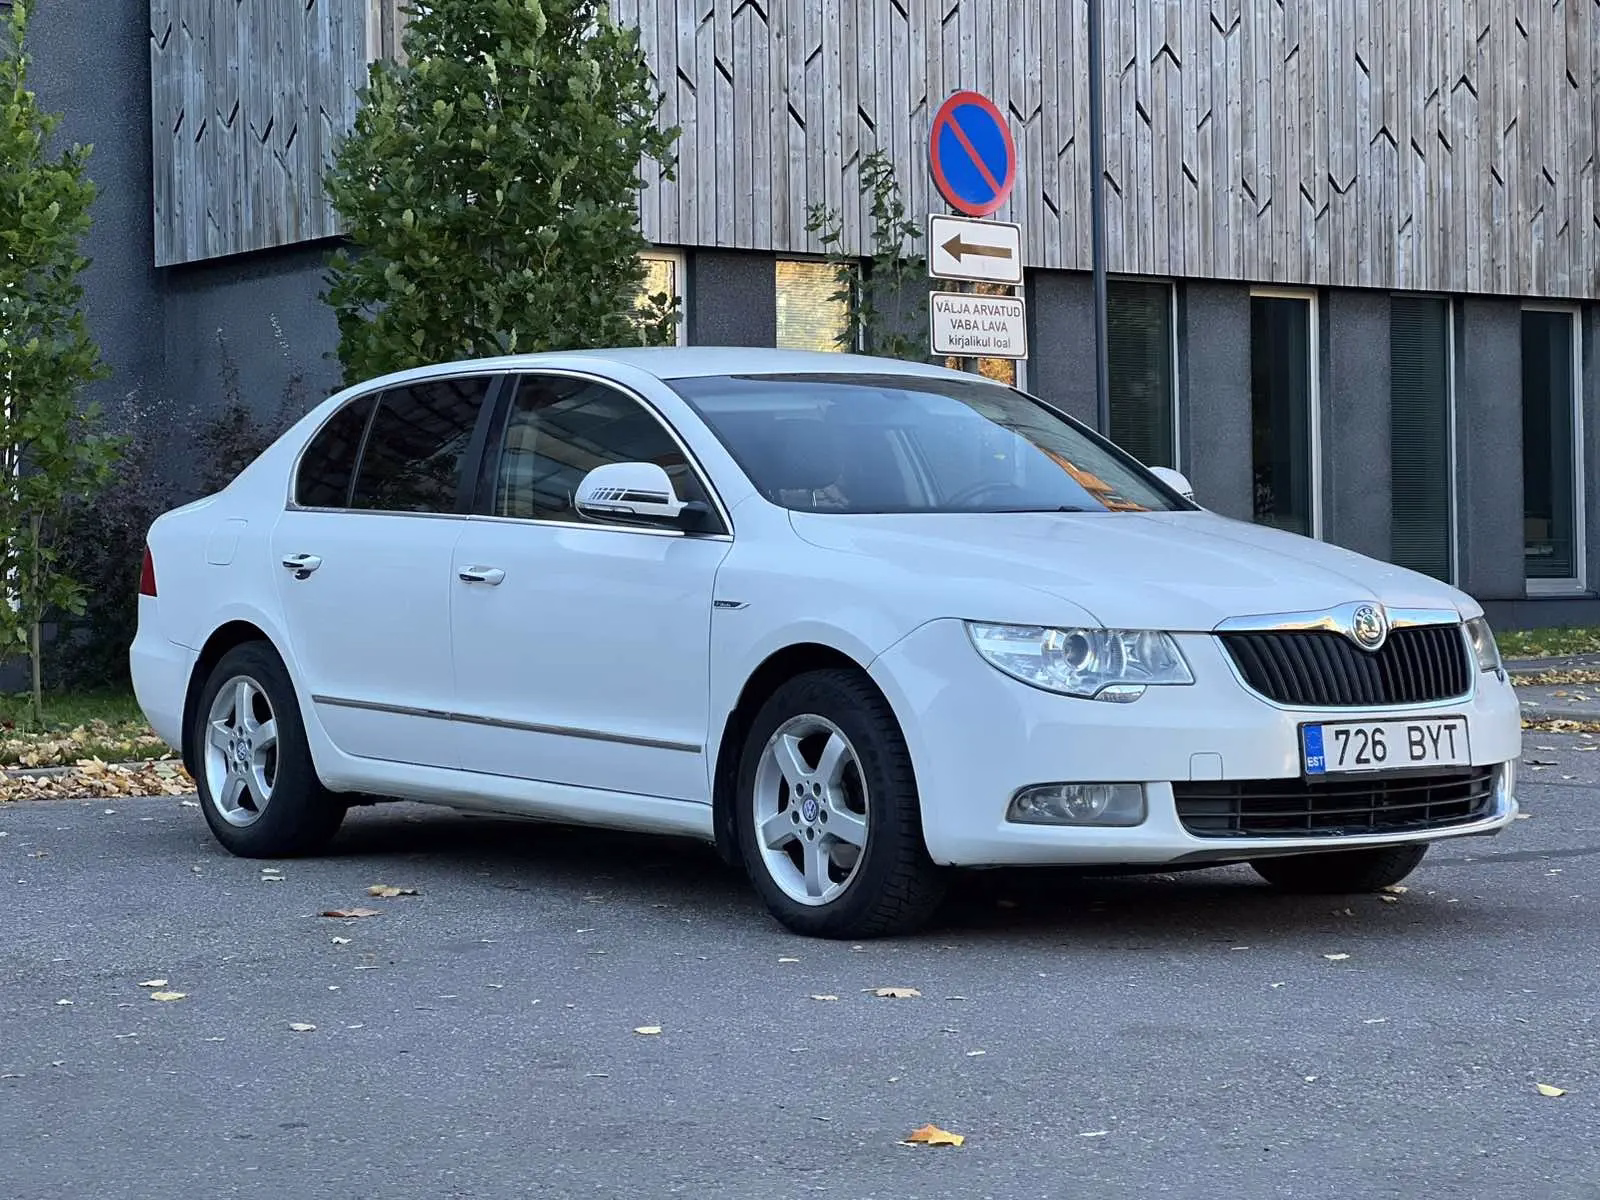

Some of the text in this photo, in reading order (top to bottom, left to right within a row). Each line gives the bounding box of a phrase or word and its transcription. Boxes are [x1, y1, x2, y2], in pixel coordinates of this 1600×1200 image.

[936, 300, 1020, 317] VÄLJA ARVATUD
[951, 319, 1008, 332] VABA LAVA
[948, 334, 1011, 349] kirjalikul loal
[1334, 724, 1457, 766] 726 BYT
[1307, 756, 1325, 767] EST
